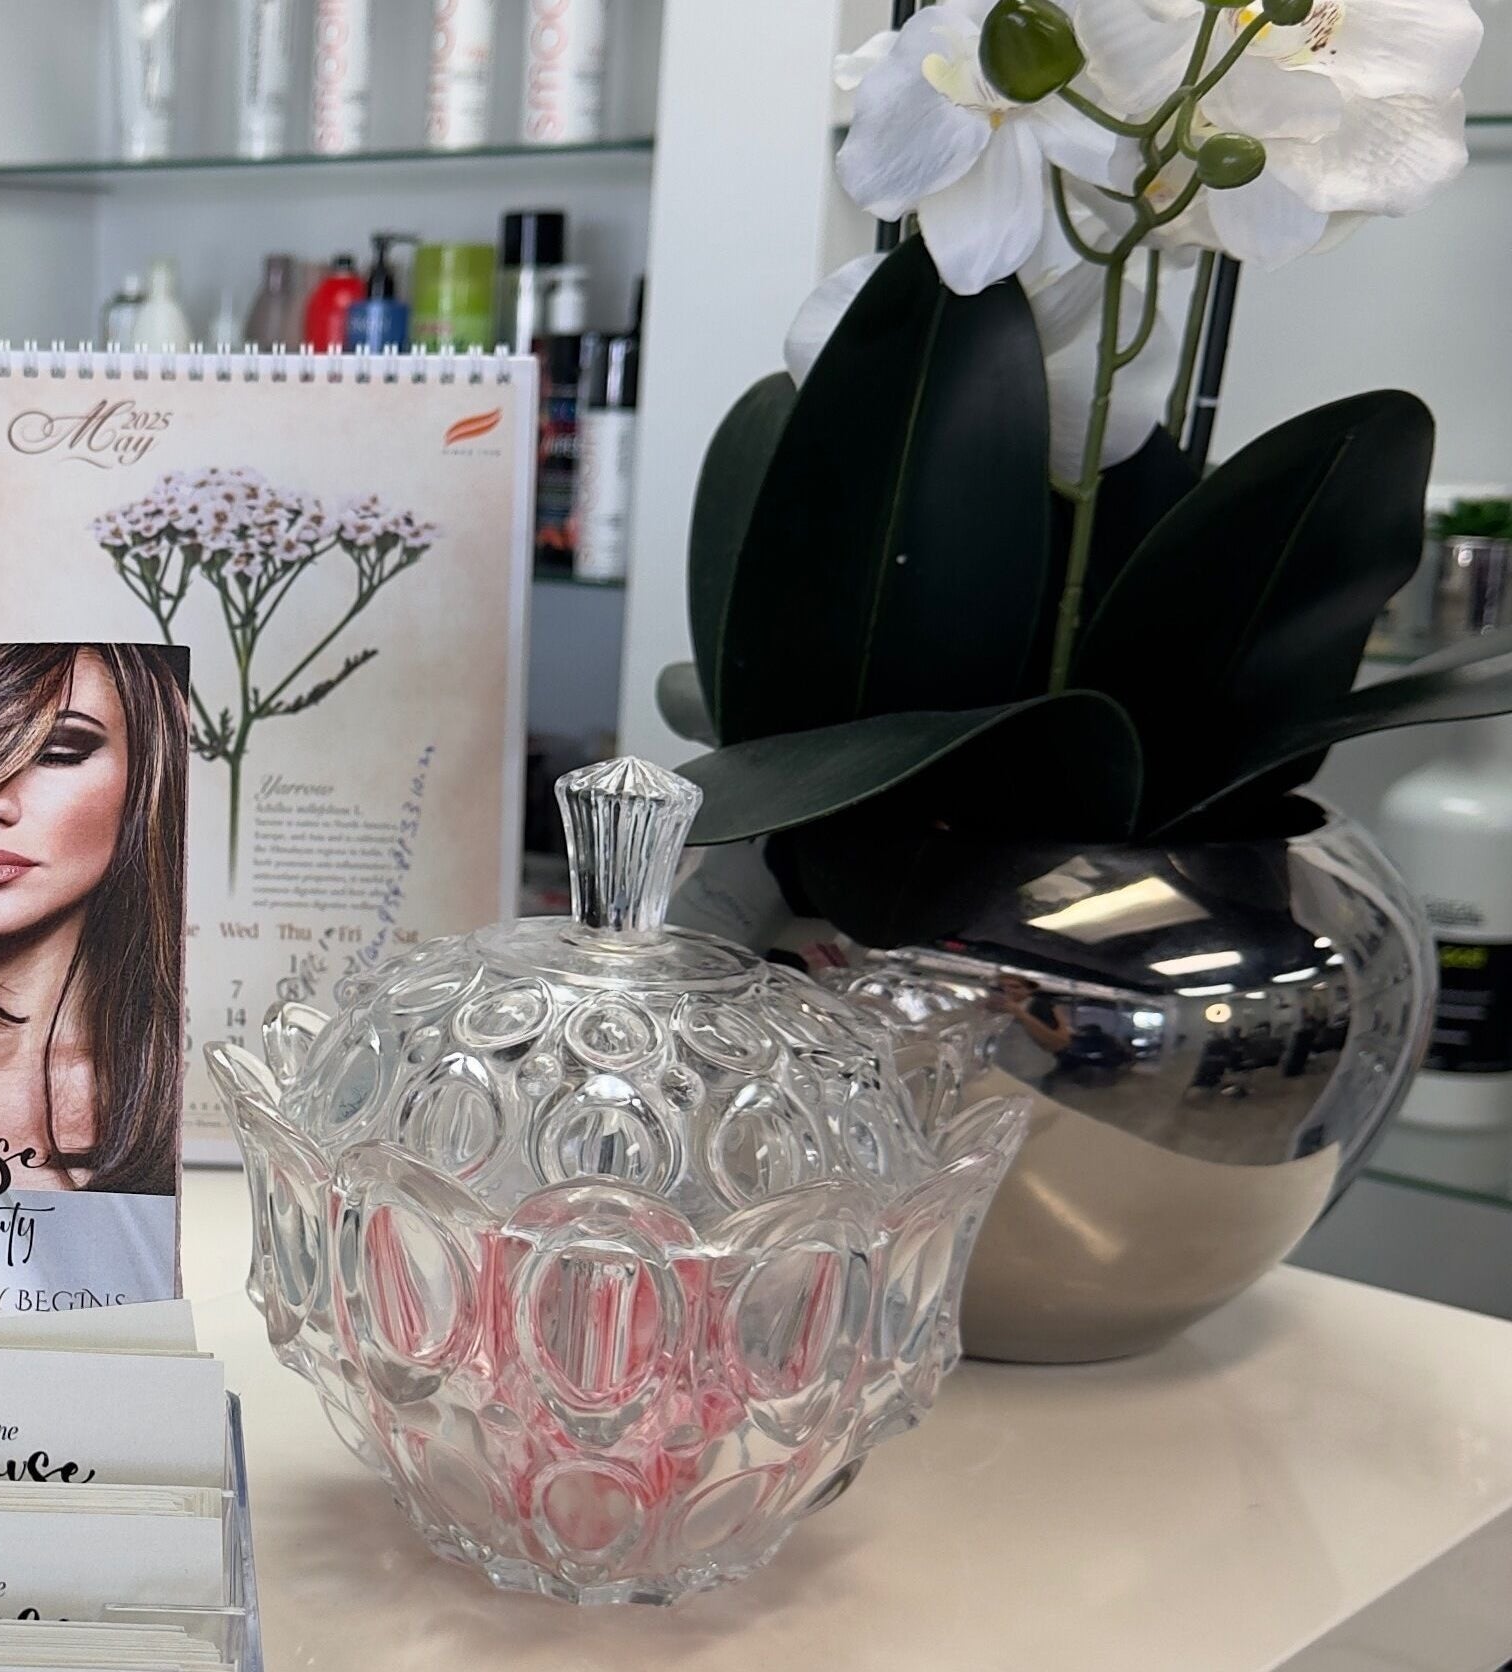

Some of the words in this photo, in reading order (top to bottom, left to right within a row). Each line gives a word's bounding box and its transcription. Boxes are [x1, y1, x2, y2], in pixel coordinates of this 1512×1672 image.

[120, 411, 175, 431] 2025
[7, 399, 155, 468] May
[254, 774, 335, 800] Yarrow
[220, 921, 260, 939] Wed
[279, 923, 313, 941] Thu
[339, 925, 362, 943] Fri
[393, 926, 420, 944] Sat
[290, 953, 298, 974] 1
[232, 979, 244, 1000] 7
[226, 1006, 247, 1028] 14
